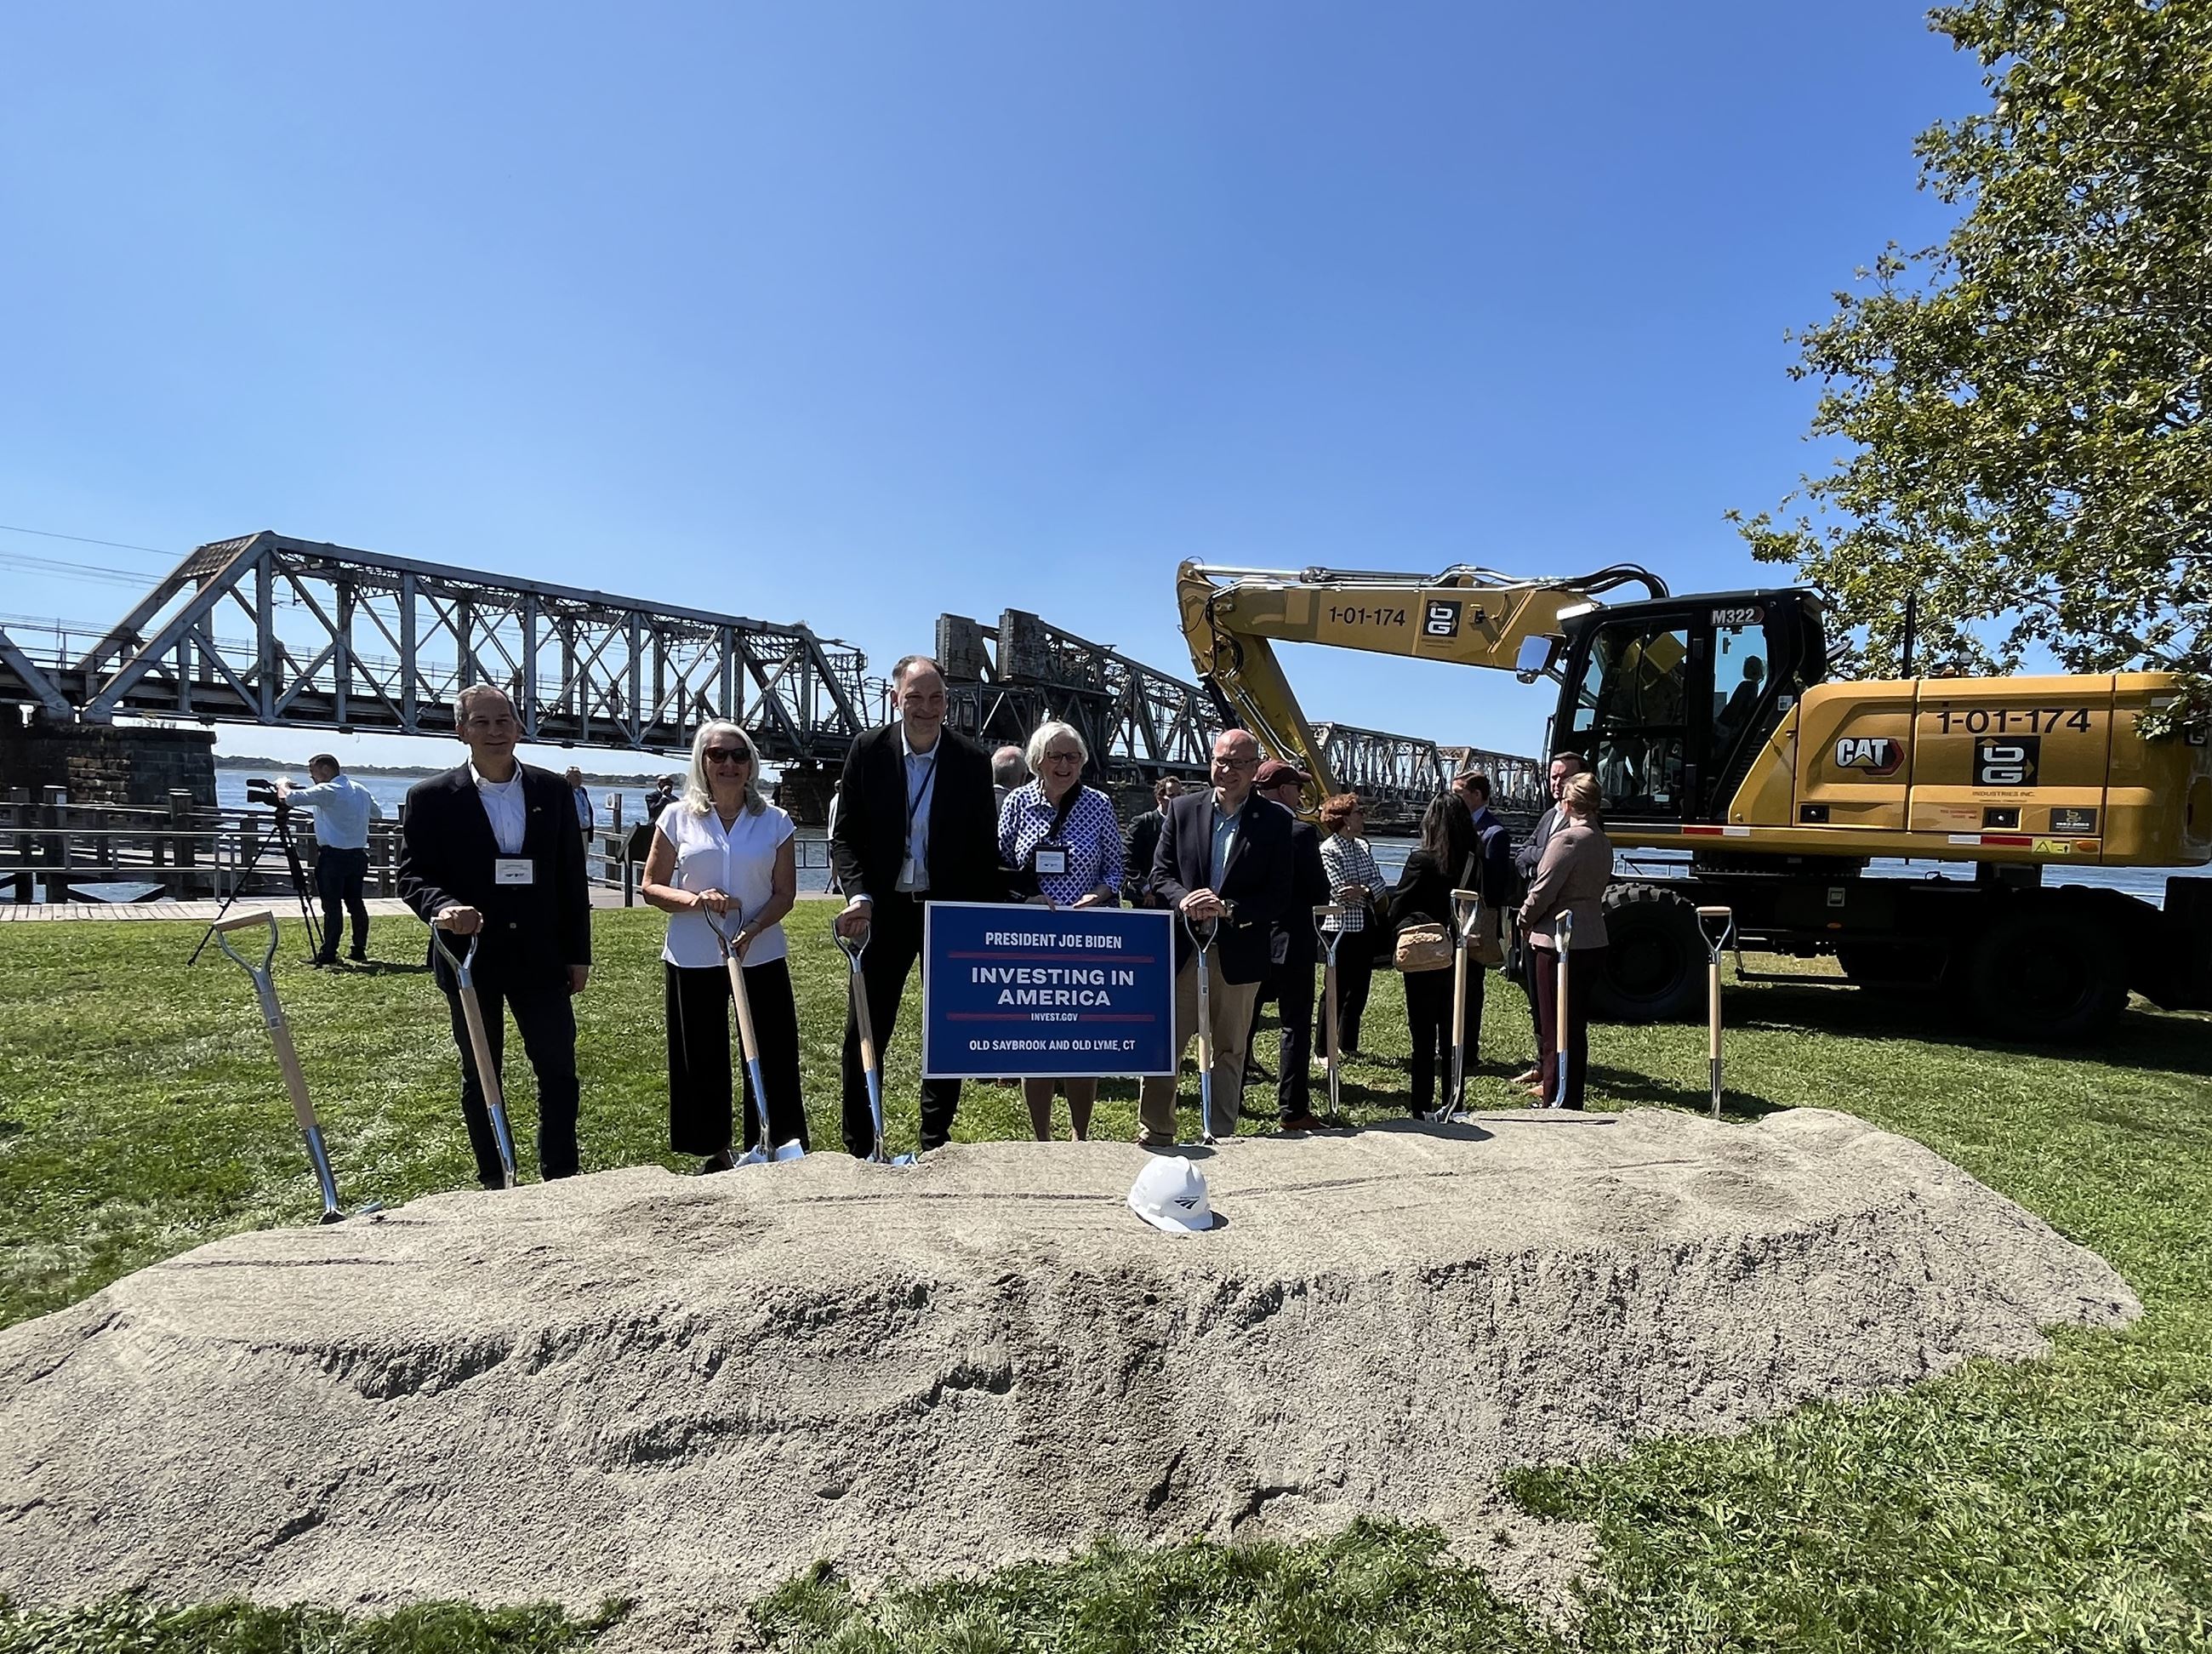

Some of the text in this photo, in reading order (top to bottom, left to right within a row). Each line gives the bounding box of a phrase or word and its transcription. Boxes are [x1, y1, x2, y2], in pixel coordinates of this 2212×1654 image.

[1329, 606, 1405, 626] 1-01-174
[1712, 607, 1755, 625] M322
[1936, 708, 2091, 734] 1-01-174
[1837, 739, 1889, 767] CAT
[985, 932, 1122, 950] PRESIDENT JOE BIDEN
[972, 967, 1135, 986] INVESTING IN
[997, 989, 1111, 1007] AMERICA
[1031, 1012, 1078, 1022] INVEST.GOV
[969, 1040, 1136, 1052] OLD SAYBROOK AND OLD LYME, CT
